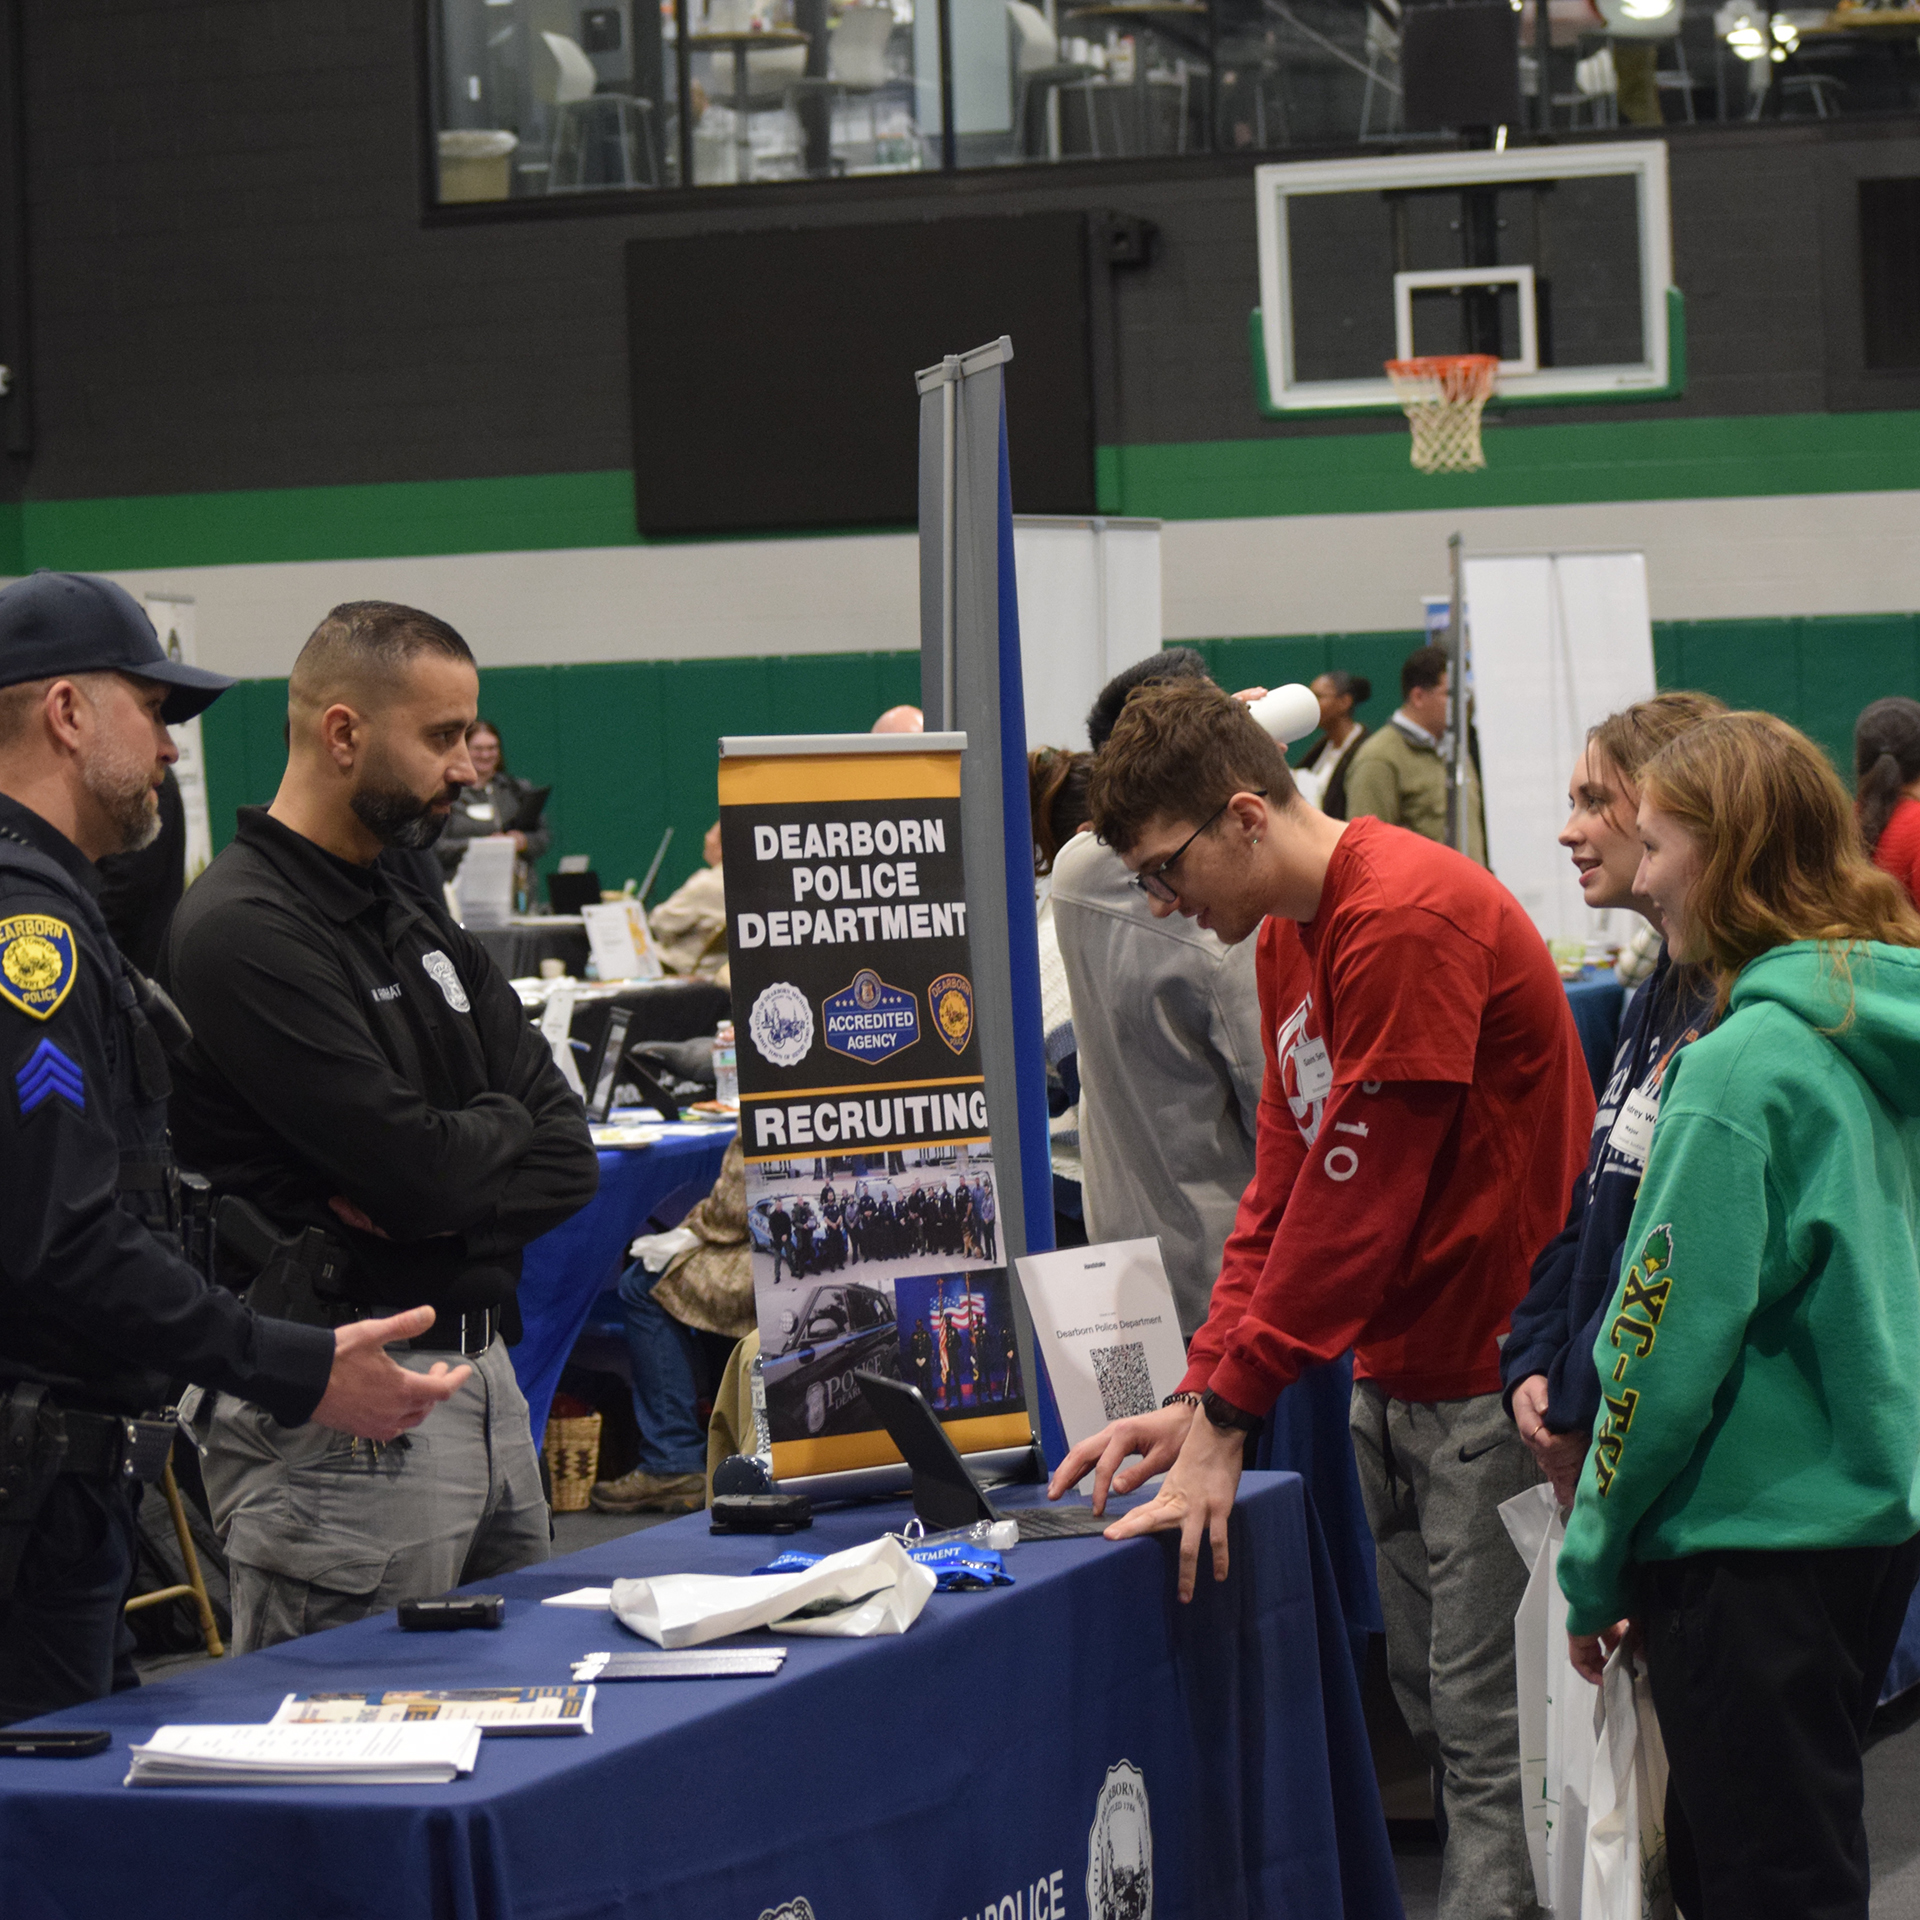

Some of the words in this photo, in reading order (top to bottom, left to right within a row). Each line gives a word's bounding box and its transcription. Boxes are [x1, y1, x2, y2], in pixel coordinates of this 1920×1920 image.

[754, 819, 946, 861] DEARBORN
[792, 862, 920, 902] POLICE
[737, 902, 967, 949] DEPARTMENT
[22, 988, 59, 1004] POLICE
[931, 978, 970, 998] DEARBORN
[828, 1011, 914, 1032] ACCREDITED
[847, 1032, 897, 1050] AGENCY
[754, 1090, 989, 1147] RECRUITING
[1056, 1326, 1094, 1339] Dearborn
[1095, 1322, 1118, 1333] Police
[1119, 1315, 1162, 1330] Department
[825, 1354, 883, 1408] POICE
[835, 1386, 862, 1411] DEAR
